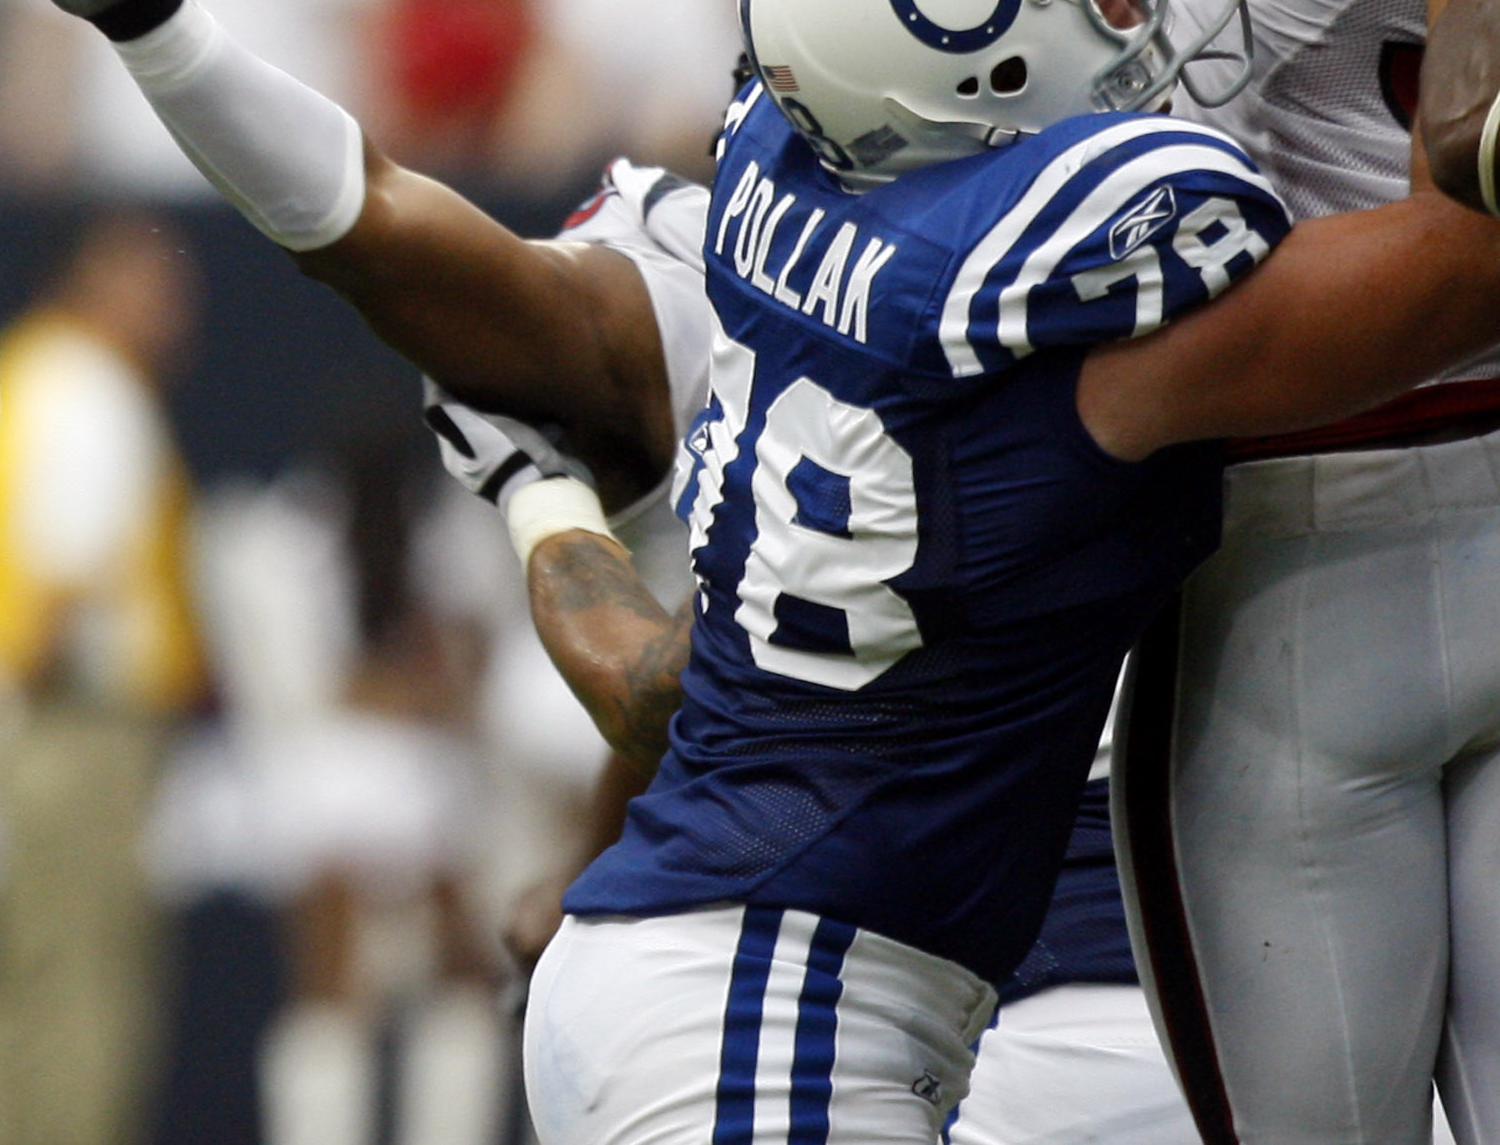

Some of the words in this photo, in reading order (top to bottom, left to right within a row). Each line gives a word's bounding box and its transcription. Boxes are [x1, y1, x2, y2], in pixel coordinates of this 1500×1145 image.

[714, 159, 897, 344] POLLAK
[1070, 197, 1271, 339] 78
[688, 328, 924, 692] 78
